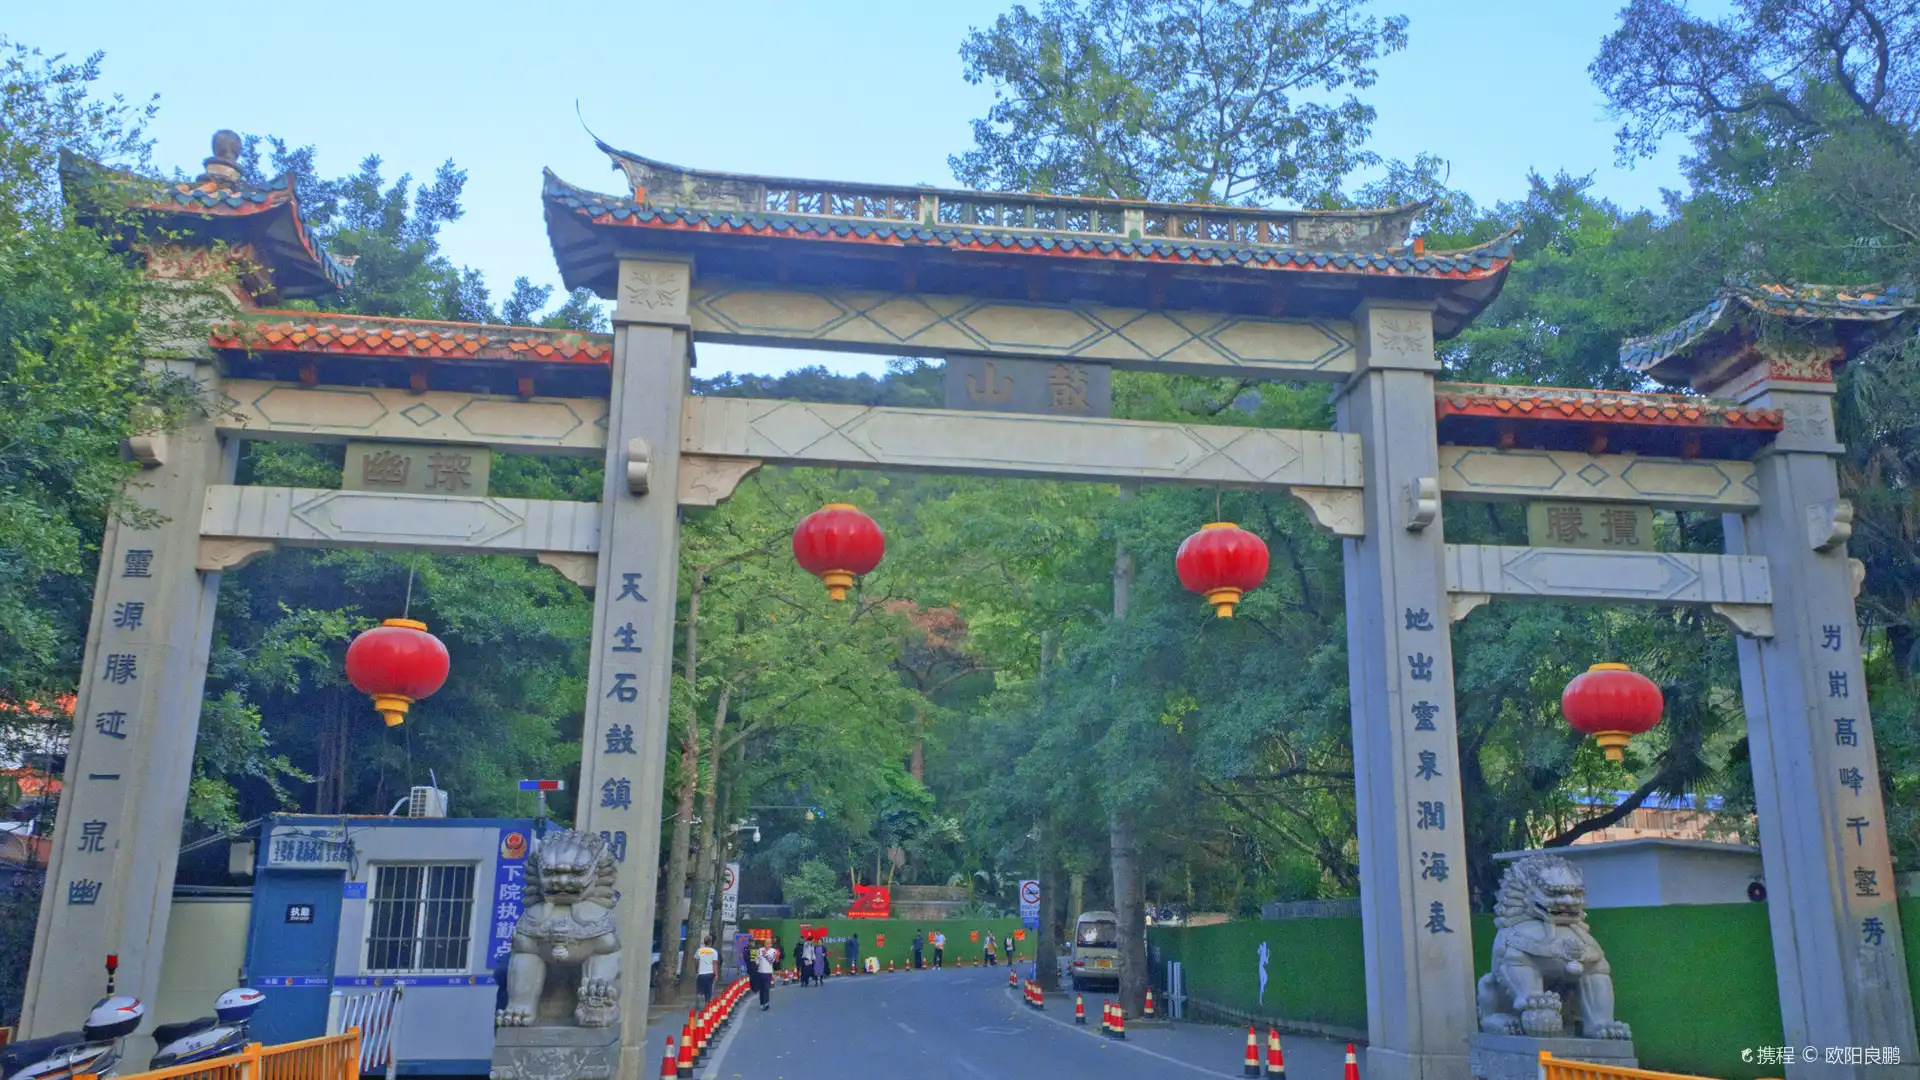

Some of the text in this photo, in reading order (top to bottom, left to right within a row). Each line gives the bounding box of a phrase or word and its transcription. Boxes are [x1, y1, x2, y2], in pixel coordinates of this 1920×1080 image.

[493, 865, 523, 959] 下院执勤点
